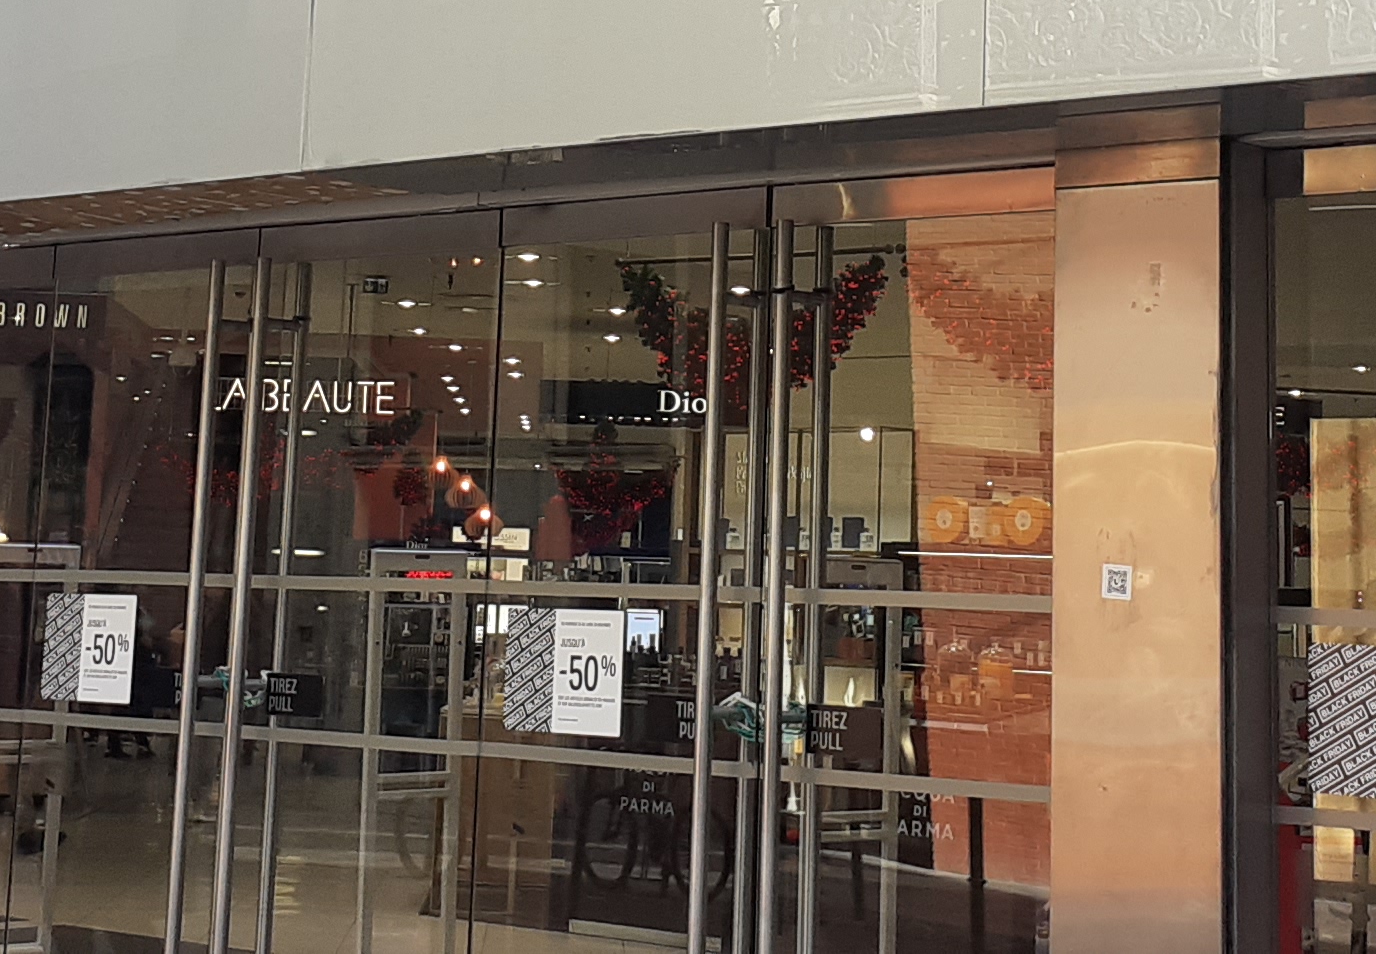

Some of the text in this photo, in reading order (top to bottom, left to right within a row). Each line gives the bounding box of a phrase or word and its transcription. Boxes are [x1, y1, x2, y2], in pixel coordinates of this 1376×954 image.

[261, 378, 395, 415] BEAUTE
[656, 389, 708, 414] Dio
[85, 633, 130, 666] -50%
[559, 654, 617, 691] -50%
[269, 676, 298, 695] TIREZ
[268, 695, 294, 713] PULL
[1320, 679, 1376, 717] BLACK FRIDAY
[676, 700, 696, 719] TIR
[679, 721, 696, 740] PU
[810, 710, 848, 731] TIREZ
[1335, 709, 1364, 732] FRIDAY
[810, 731, 844, 752] PULL
[642, 780, 655, 793] DI
[619, 797, 674, 817] PARMA
[913, 804, 927, 818] DI
[897, 820, 954, 841] ARMA
